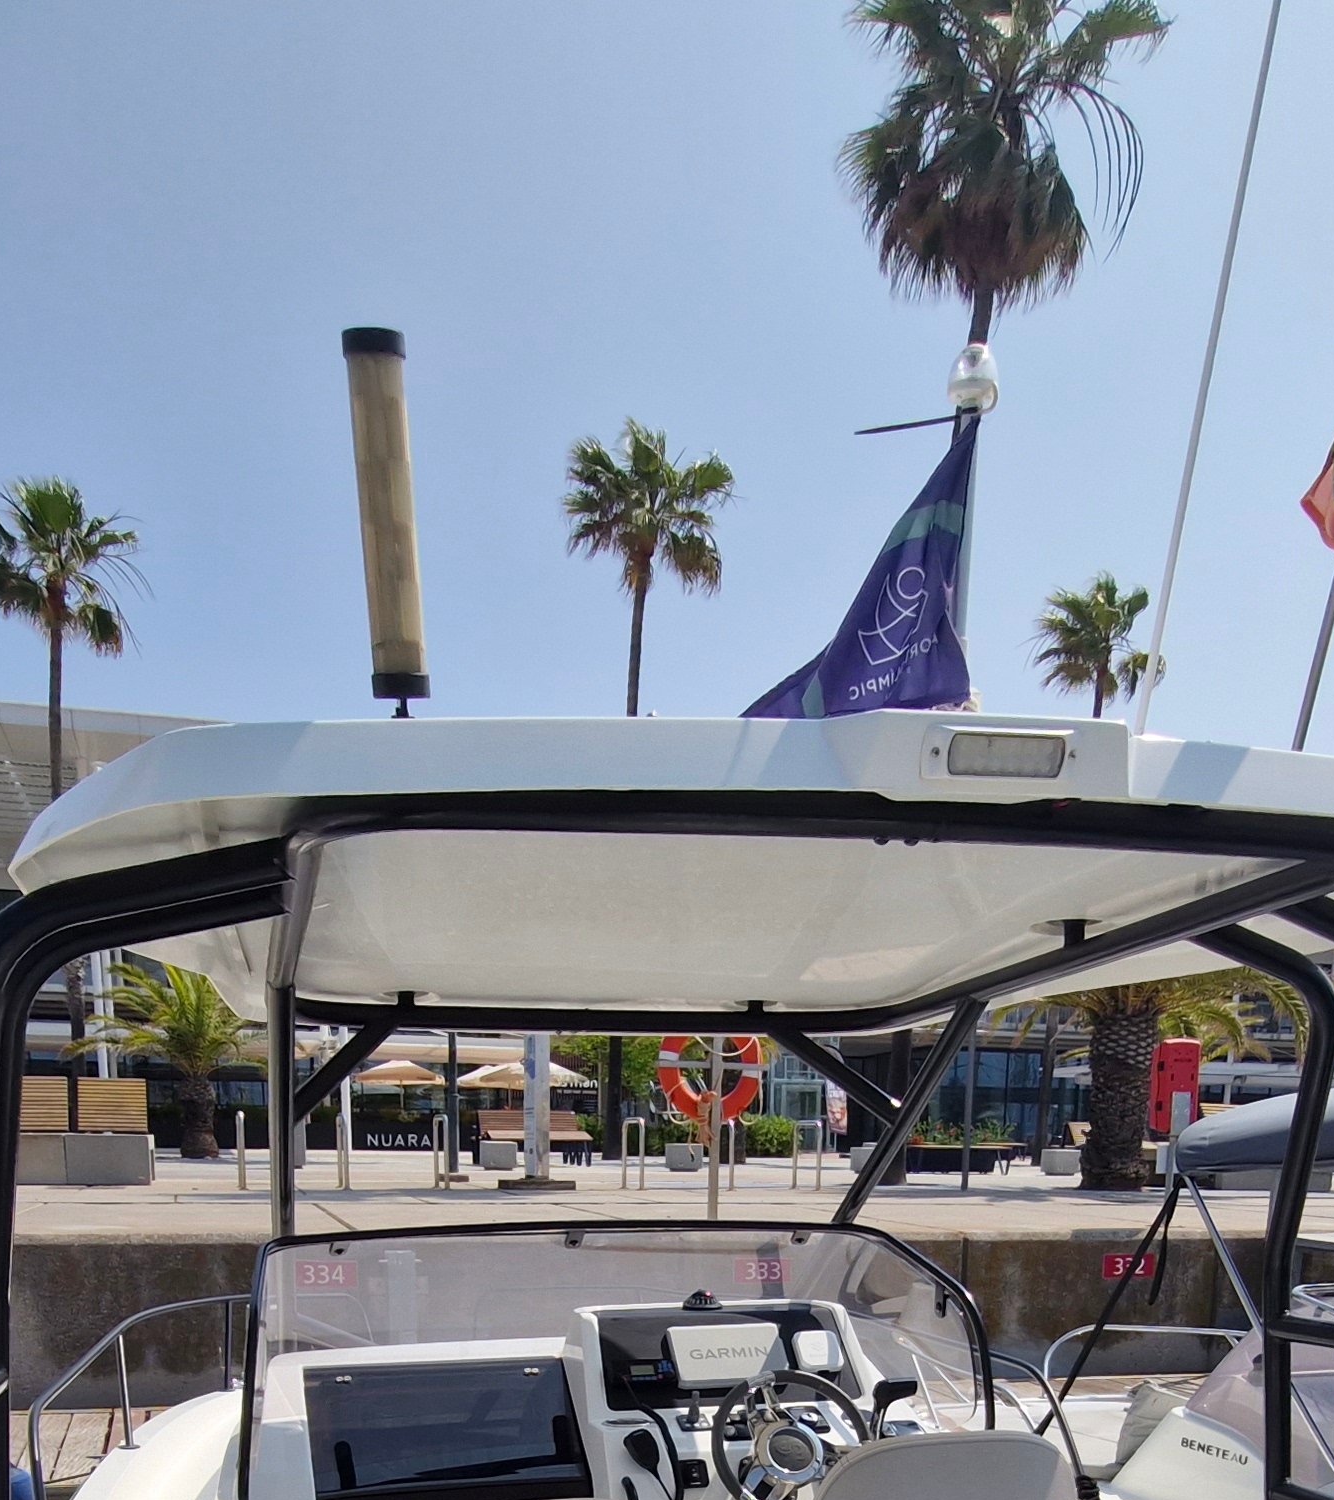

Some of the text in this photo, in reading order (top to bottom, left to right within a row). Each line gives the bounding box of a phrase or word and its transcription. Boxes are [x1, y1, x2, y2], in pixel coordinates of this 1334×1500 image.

[367, 1133, 432, 1147] NUARA
[303, 1264, 345, 1284] 334
[744, 1262, 782, 1280] 333
[689, 1346, 769, 1361] GARMIN
[1180, 1437, 1249, 1466] BENETEAU
